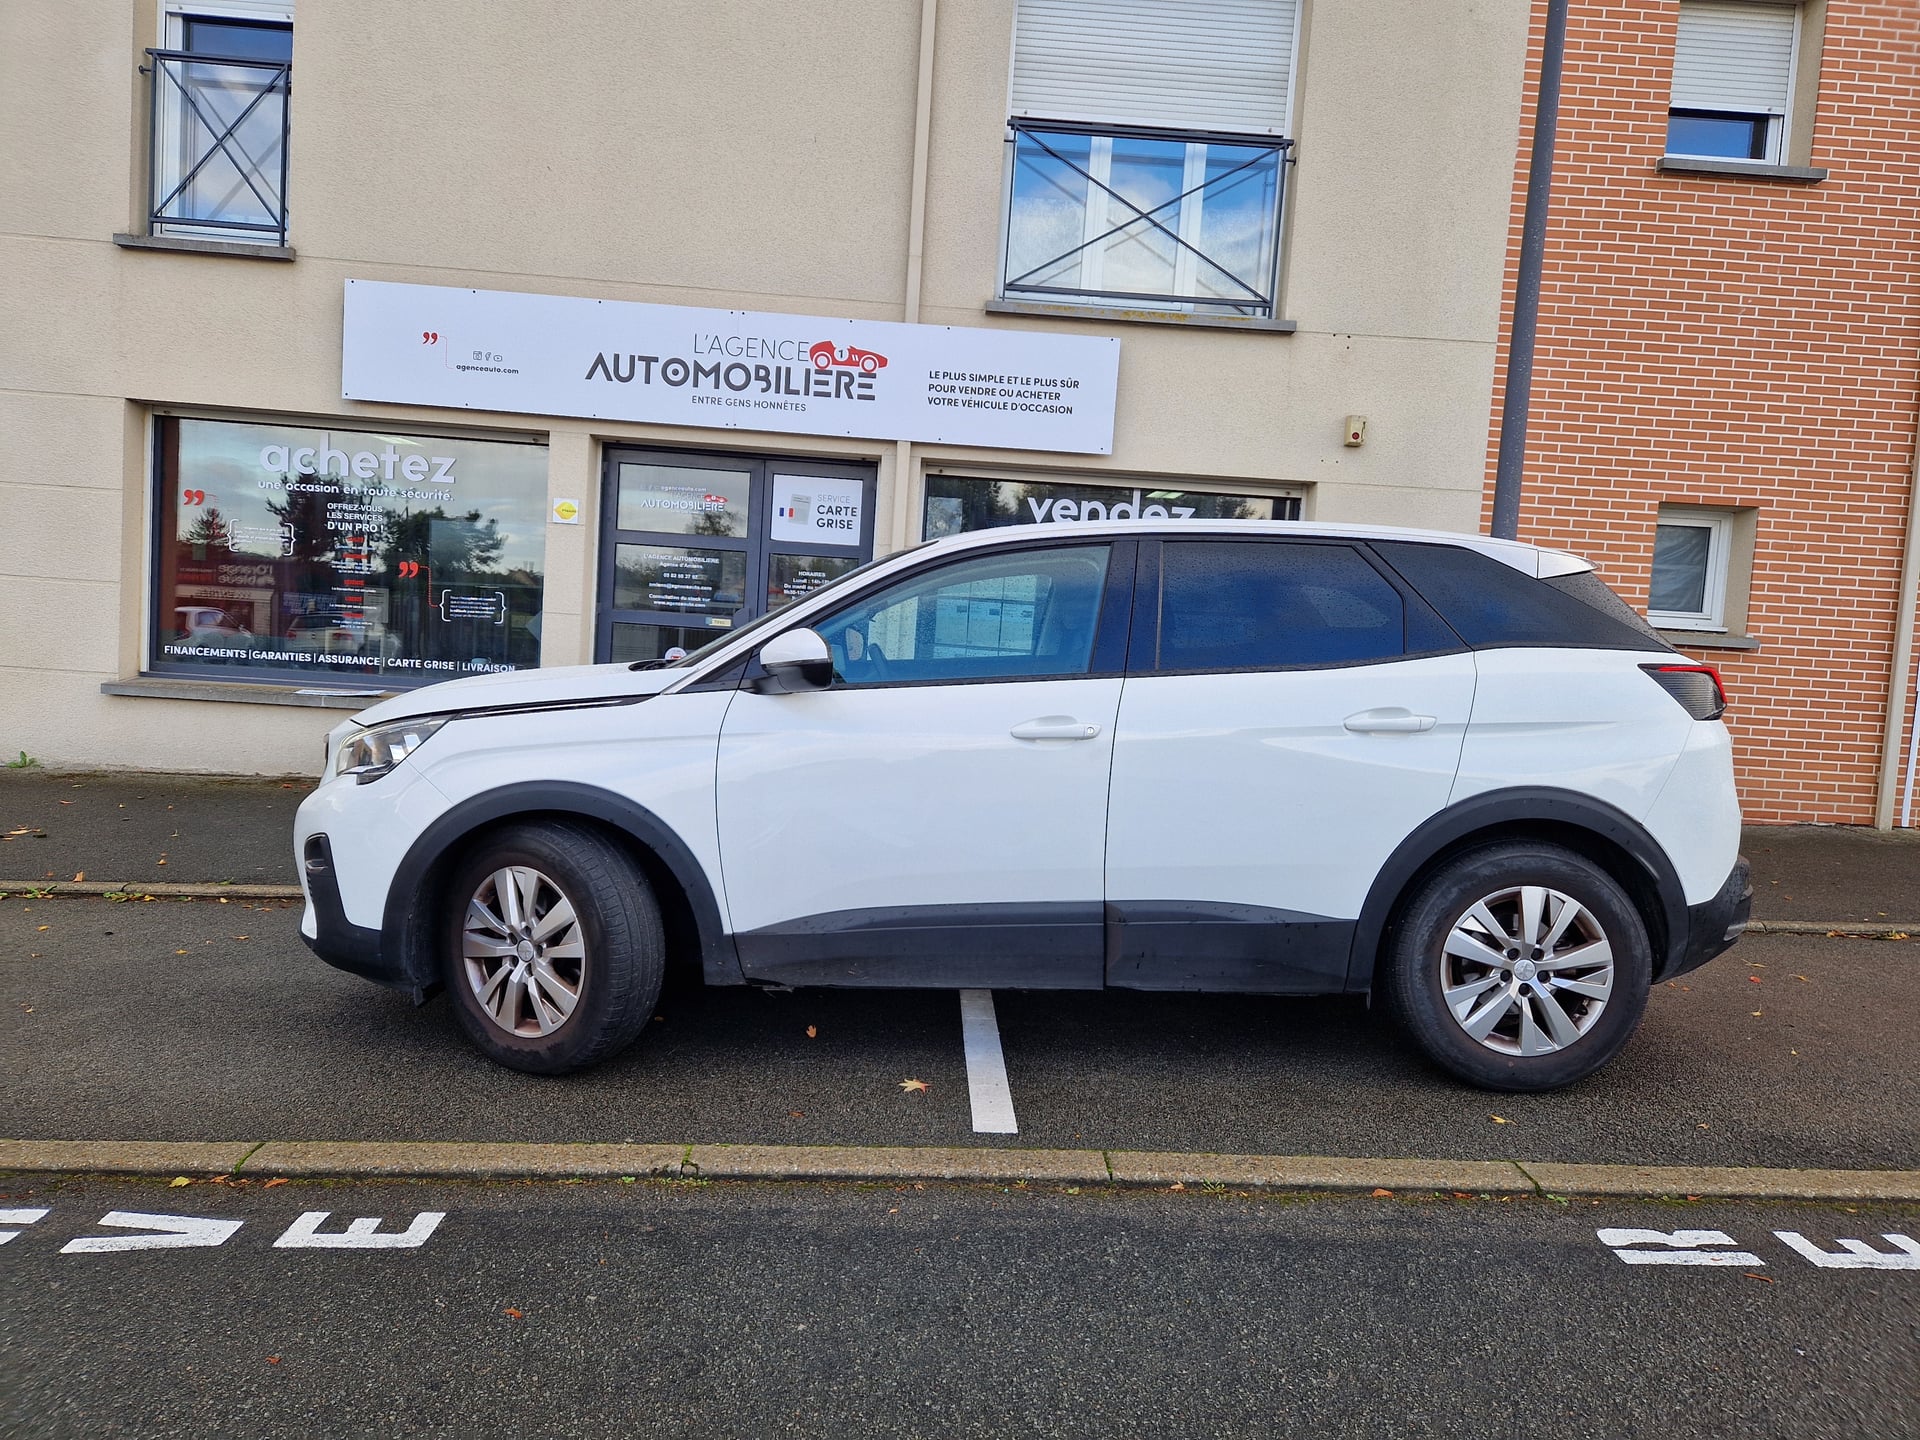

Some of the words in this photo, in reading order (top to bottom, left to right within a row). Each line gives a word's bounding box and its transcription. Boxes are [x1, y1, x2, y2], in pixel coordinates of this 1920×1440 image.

[694, 333, 809, 361] L'AGENCE
[456, 363, 519, 375] agenceauto.com
[929, 370, 940, 380] LE
[942, 371, 967, 381] PLUS
[969, 373, 1005, 384] SIMPLE
[1007, 376, 1019, 385] ET
[1020, 377, 1031, 386] LE
[1034, 378, 1058, 388] PLUS
[1060, 377, 1080, 389] SÛR
[928, 383, 956, 394] POUR
[958, 385, 997, 397] VENDRE
[999, 388, 1014, 398] OU
[1015, 390, 1061, 401] ACHETER
[691, 395, 723, 406] ENTRE
[725, 397, 751, 408] GENS
[754, 400, 807, 412] HONNÊTES
[928, 396, 959, 407] VOTRE
[961, 397, 1009, 411] VÉHICULE
[1010, 402, 1073, 415] D'OCCASION
[260, 432, 456, 484] achetez
[258, 480, 282, 490] une
[285, 481, 339, 495] occasion
[343, 486, 359, 496] en
[363, 486, 397, 498] toute
[327, 502, 383, 513] OFFREZ-VOUS
[817, 494, 851, 504] SERVICE
[1027, 488, 1196, 523] vendez
[326, 511, 342, 520] LES
[344, 512, 383, 522] SERVICES
[816, 504, 858, 517] CARTE
[327, 521, 353, 532] D'UN
[355, 522, 378, 533] PRO
[816, 517, 853, 530] GRISE
[164, 645, 247, 659] FINANCEMENTS
[252, 650, 312, 663] GARANTIES
[317, 653, 381, 667] ASSURANCE
[387, 658, 422, 669] CARTE
[424, 660, 455, 671] GRISE
[462, 662, 515, 673] LIVRAISON
